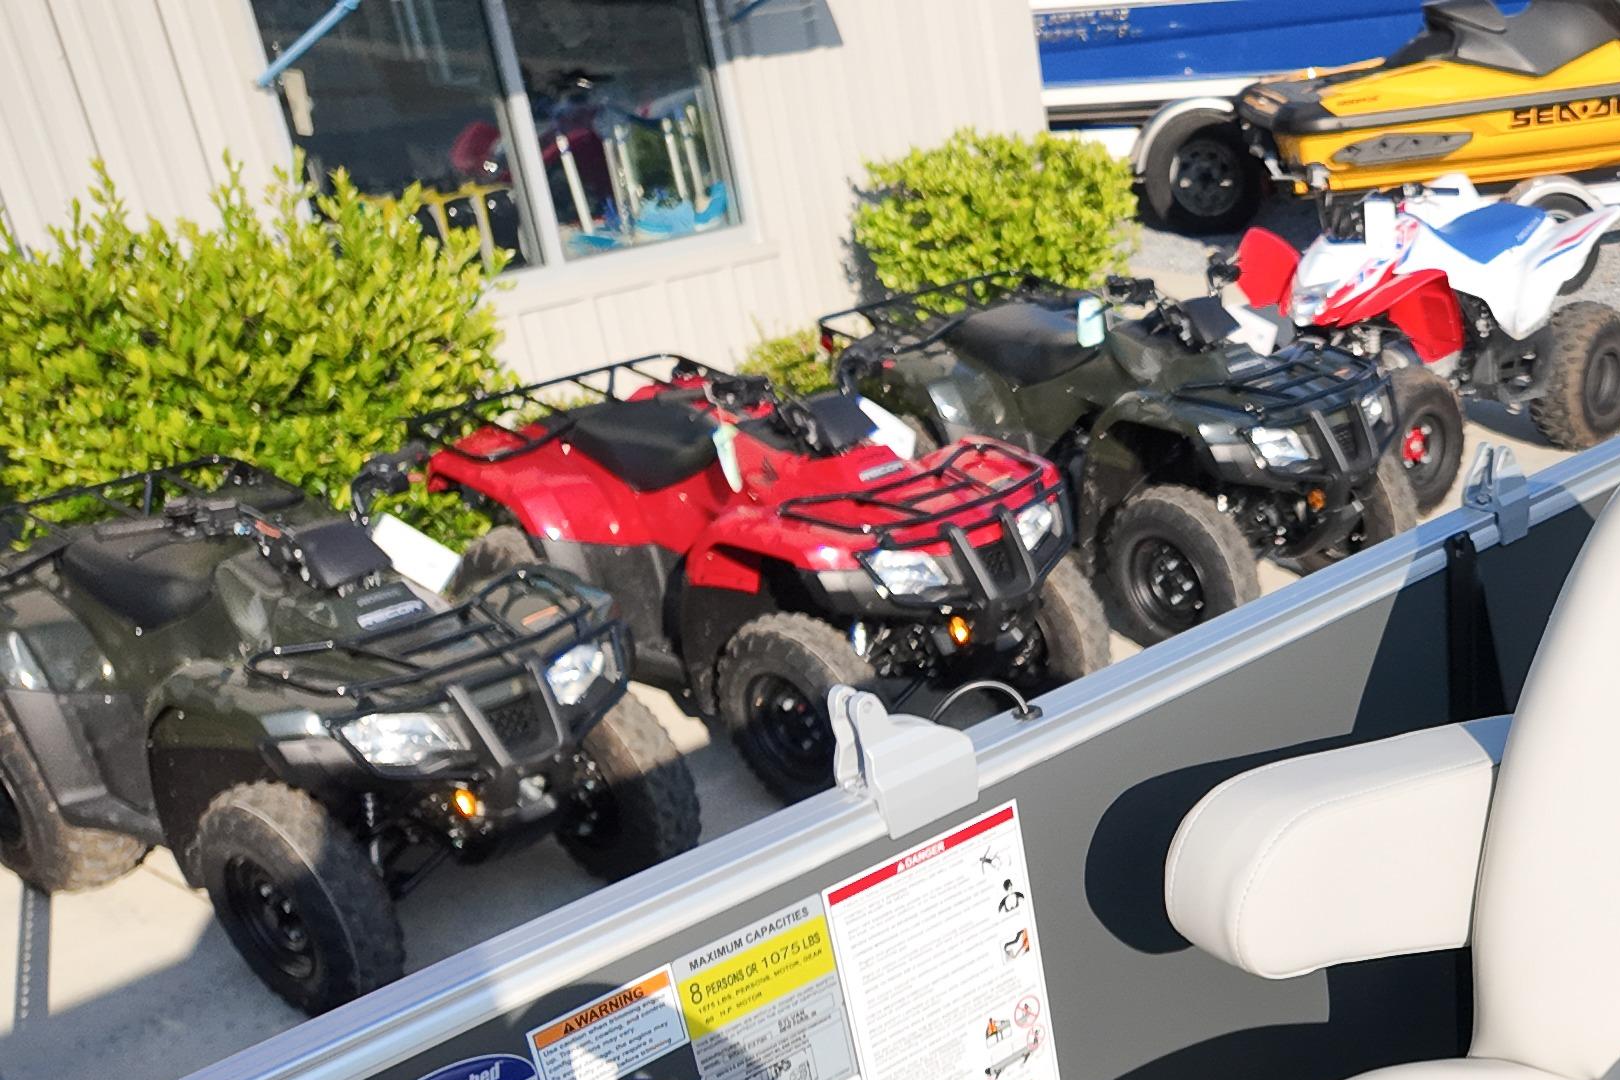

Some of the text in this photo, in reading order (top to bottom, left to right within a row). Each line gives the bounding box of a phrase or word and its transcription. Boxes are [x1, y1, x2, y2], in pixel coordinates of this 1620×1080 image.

[905, 840, 945, 869] DANGER
[689, 905, 808, 972] MAXIMUM CAPACITIES
[688, 931, 820, 1006] 8 PERSONS OR 1075 LBS
[575, 987, 644, 1027] WARNING
